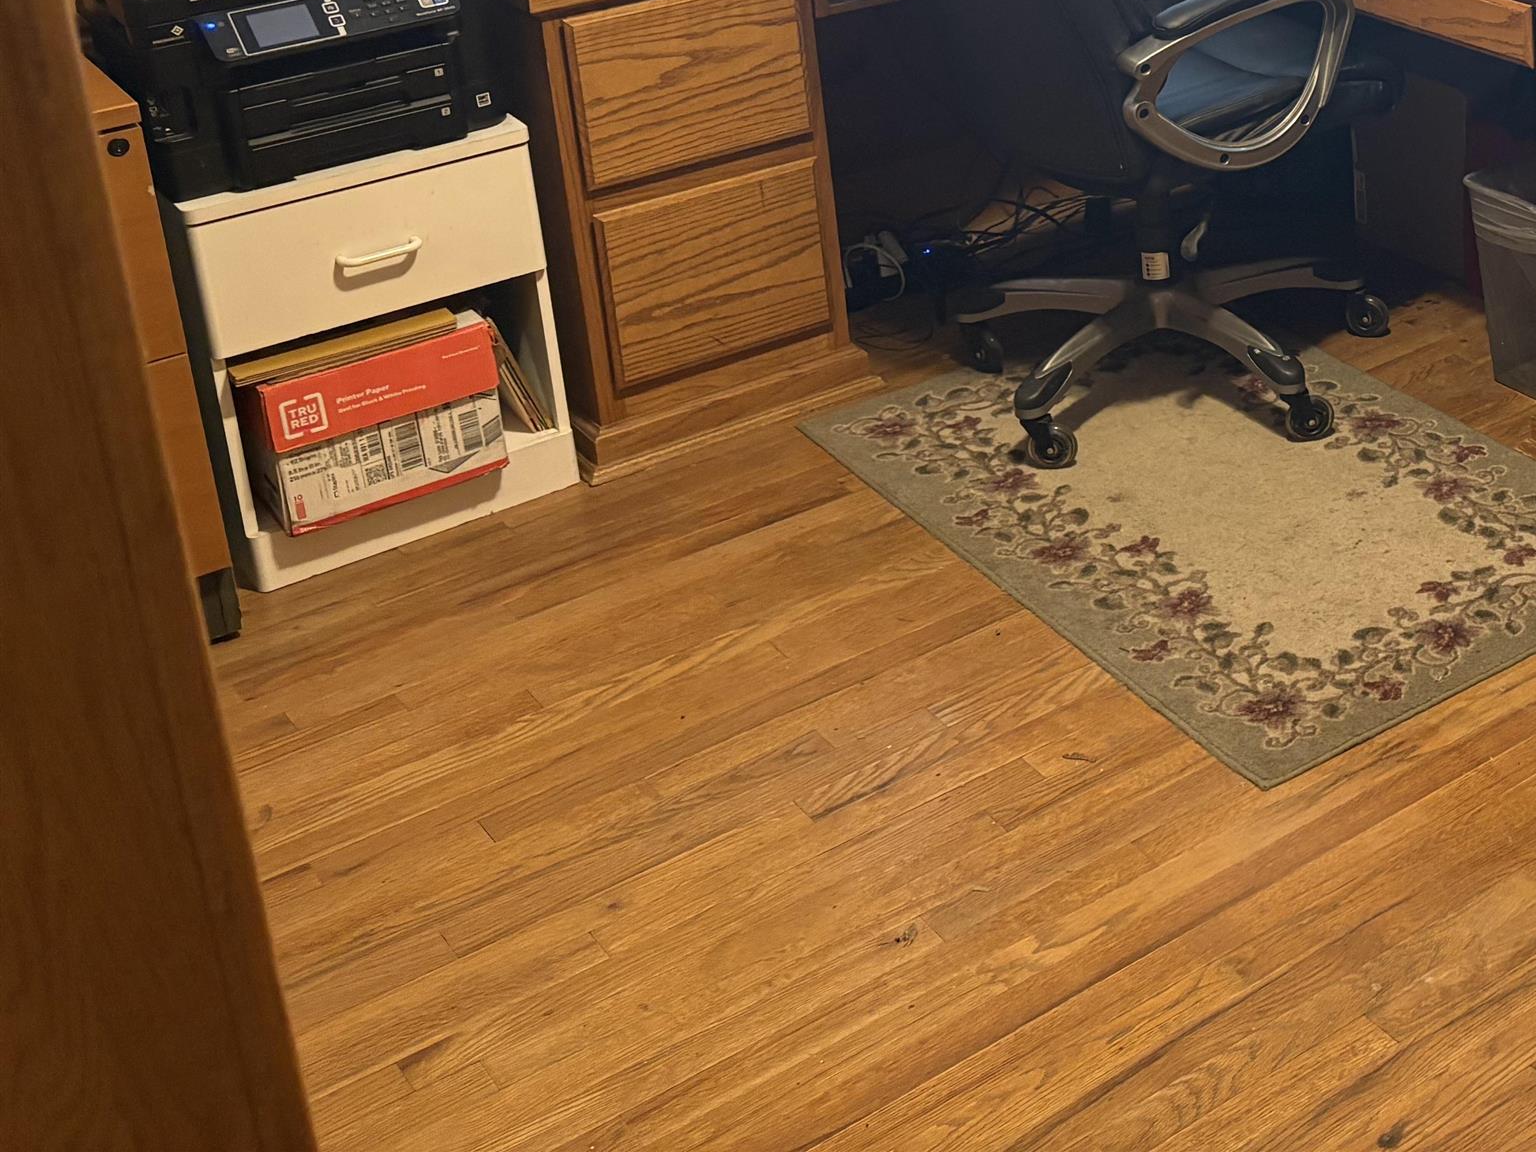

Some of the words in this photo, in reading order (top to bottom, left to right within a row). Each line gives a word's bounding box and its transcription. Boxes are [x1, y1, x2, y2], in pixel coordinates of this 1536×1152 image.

[336, 393, 365, 404] Printer
[366, 384, 390, 396] Paper
[288, 403, 317, 418] TRU
[290, 414, 318, 430] RED
